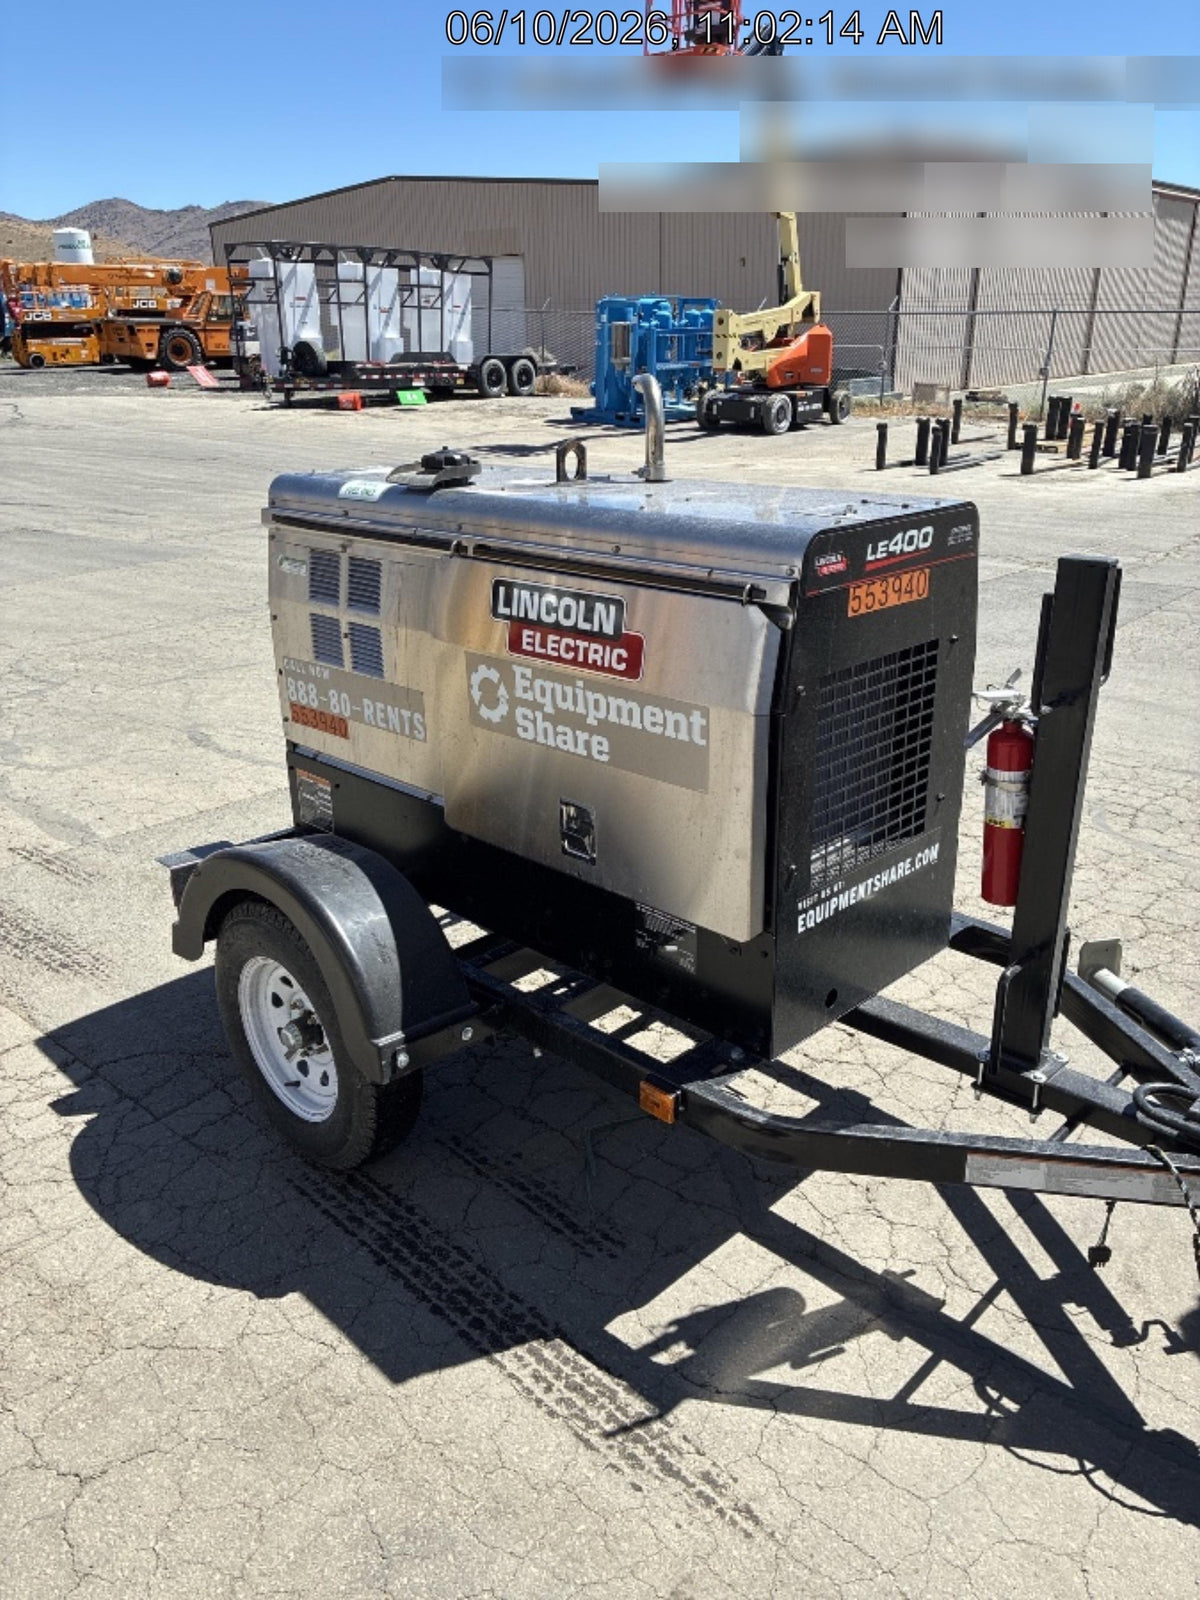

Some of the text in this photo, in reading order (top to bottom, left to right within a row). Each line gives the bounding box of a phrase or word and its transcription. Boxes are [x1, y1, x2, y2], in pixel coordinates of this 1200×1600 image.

[866, 526, 934, 561] LE400
[497, 586, 616, 635] LINCOLN
[851, 571, 927, 613] 553940
[521, 629, 628, 671] ELECTRIC
[286, 677, 426, 740] 888-80-RENTS
[291, 703, 349, 738] 553940
[511, 664, 707, 746] Equipment
[514, 706, 611, 762] Share
[798, 842, 940, 934] EQUIPMENTSHARE.COM
